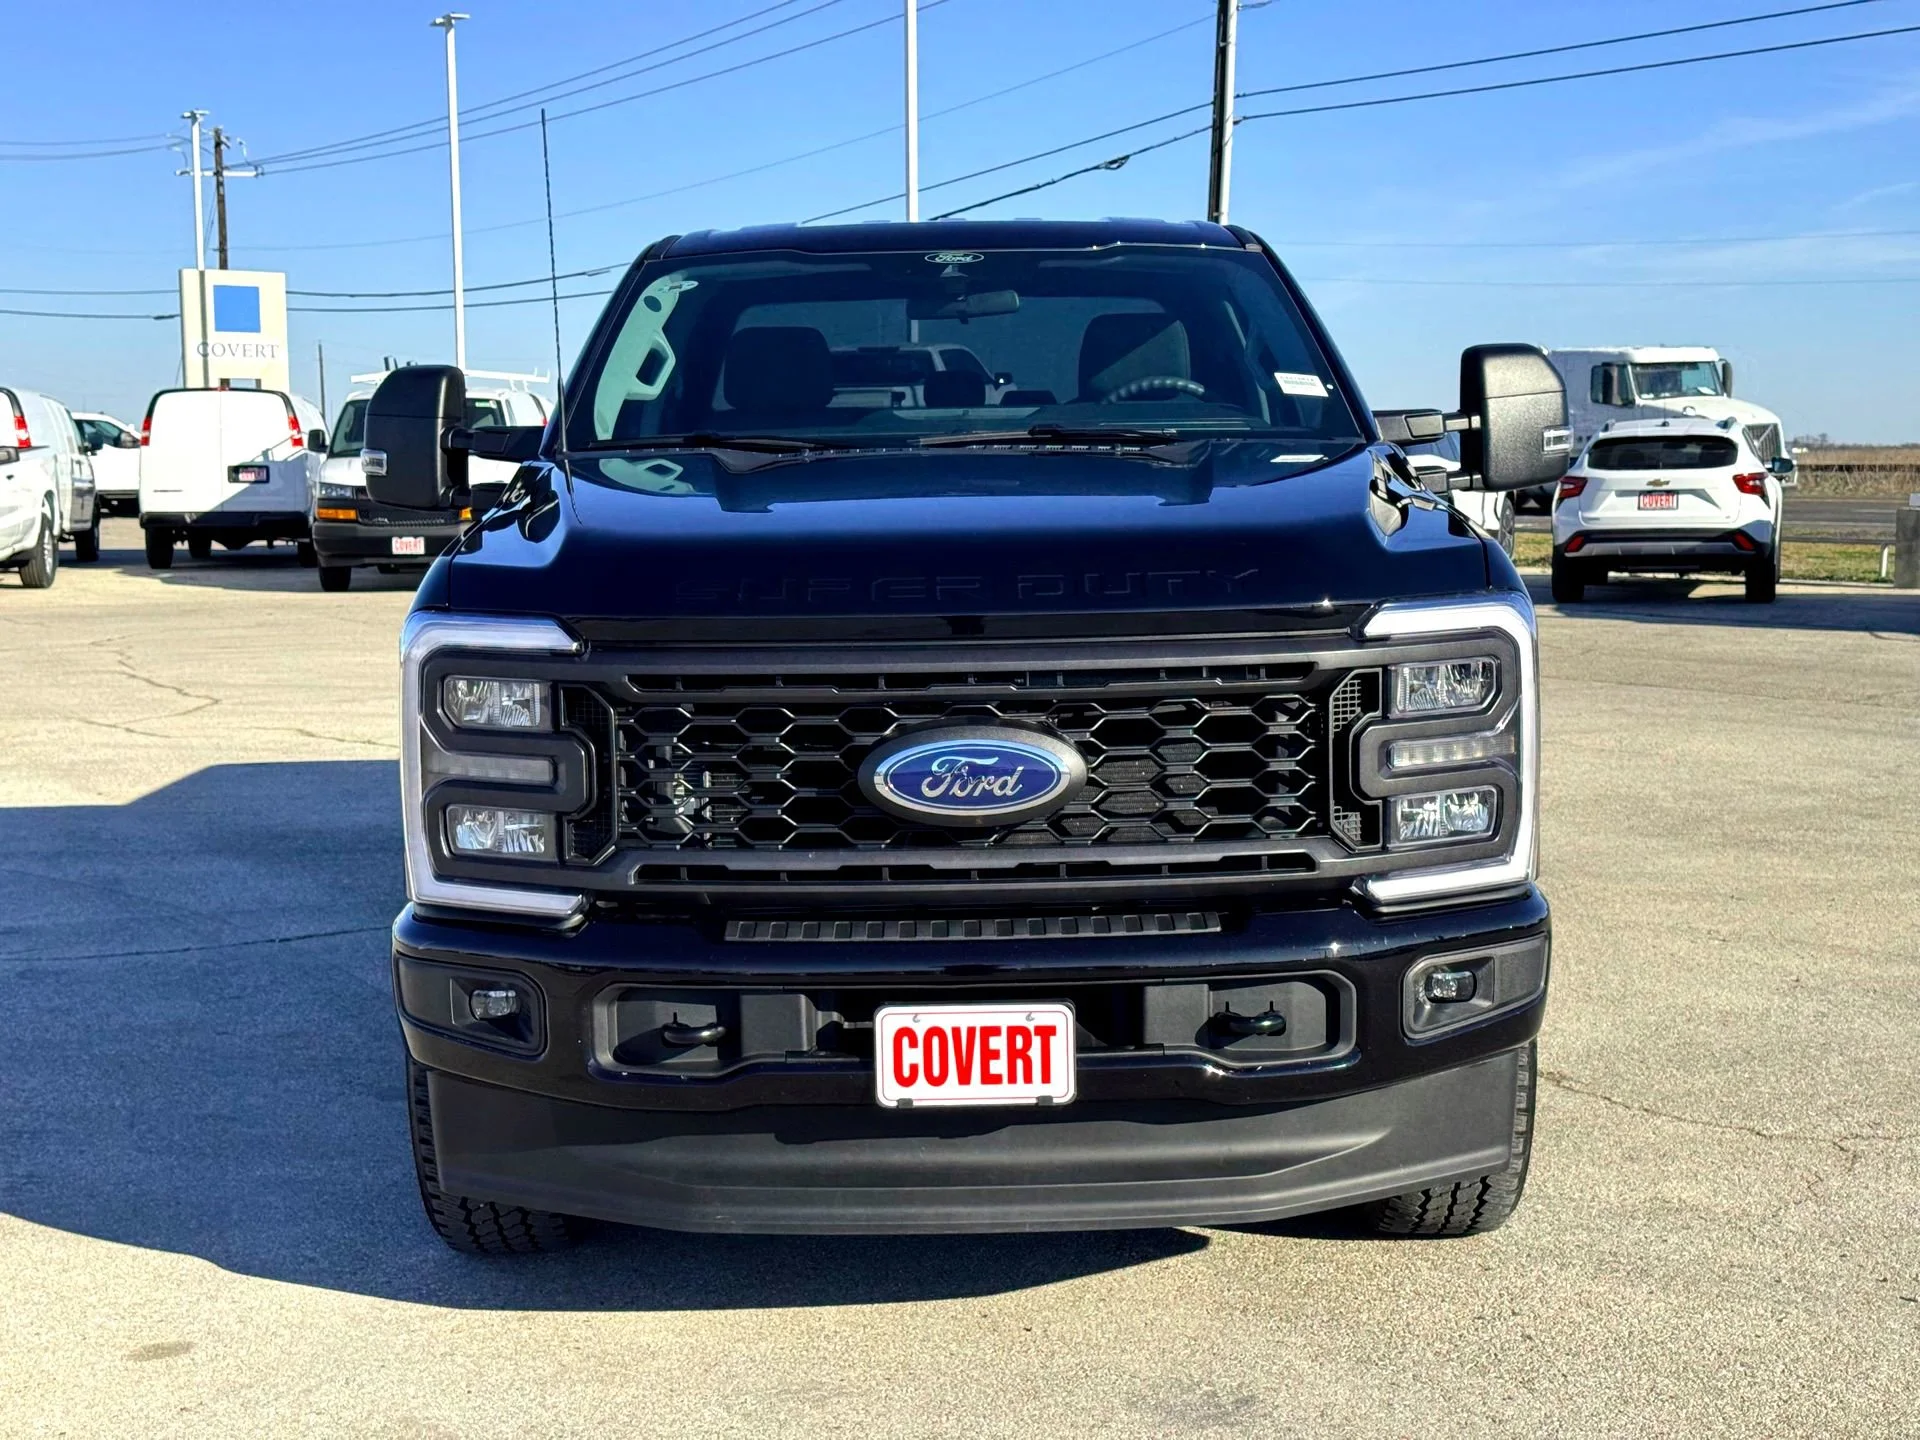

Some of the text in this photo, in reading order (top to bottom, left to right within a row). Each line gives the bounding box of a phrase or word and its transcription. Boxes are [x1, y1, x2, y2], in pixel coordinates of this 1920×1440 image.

[197, 342, 279, 358] COVERT
[1643, 494, 1675, 507] COVERT
[675, 569, 1259, 603] SUPER DUTY
[921, 756, 1023, 798] Ford
[893, 1025, 1056, 1087] COVERT
